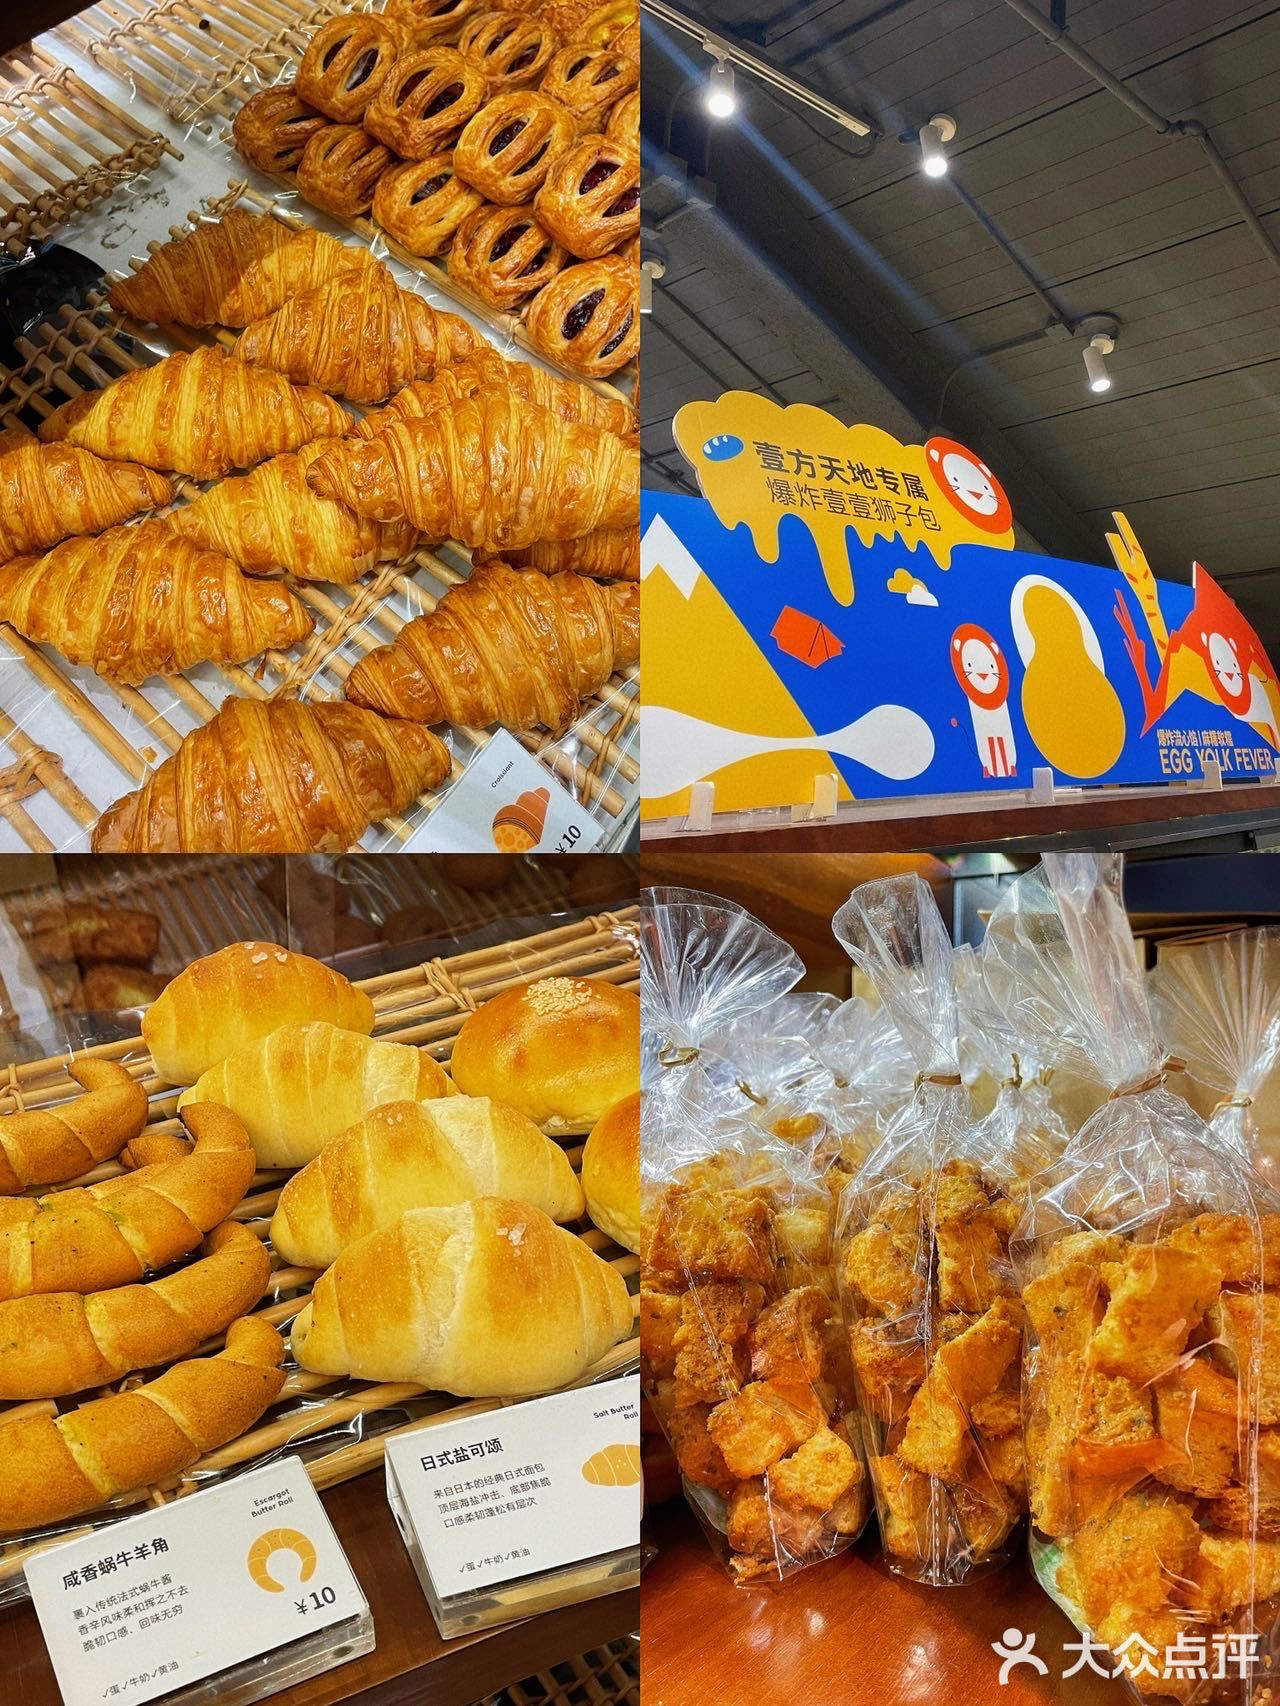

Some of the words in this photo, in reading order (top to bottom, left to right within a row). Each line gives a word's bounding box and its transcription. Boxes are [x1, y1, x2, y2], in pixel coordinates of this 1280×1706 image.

[752, 440, 929, 502] 壹方天地专属
[766, 476, 941, 532] 爆炸壹壹狮子包
[1159, 748, 1194, 774] EGG
[1195, 747, 1233, 773] YOLK
[1234, 747, 1275, 771] FEVER
[593, 1408, 610, 1419] Salt
[610, 1403, 635, 1416] Butter
[623, 1411, 639, 1421] Roll
[420, 1437, 504, 1472] 日式盐可颂
[253, 1487, 290, 1508] Escargot
[433, 1462, 545, 1500] 来自日本的经典日式面包
[251, 1502, 277, 1518] Butter
[277, 1496, 294, 1510] Roll
[443, 1496, 538, 1529] 口感柔韧蓬松有层次
[62, 1536, 169, 1591] 咸香蜗牛羊角
[71, 1573, 173, 1621] 裹入传统法式蜗牛酱
[77, 1585, 190, 1636] 香辛风味柔和挥之不去
